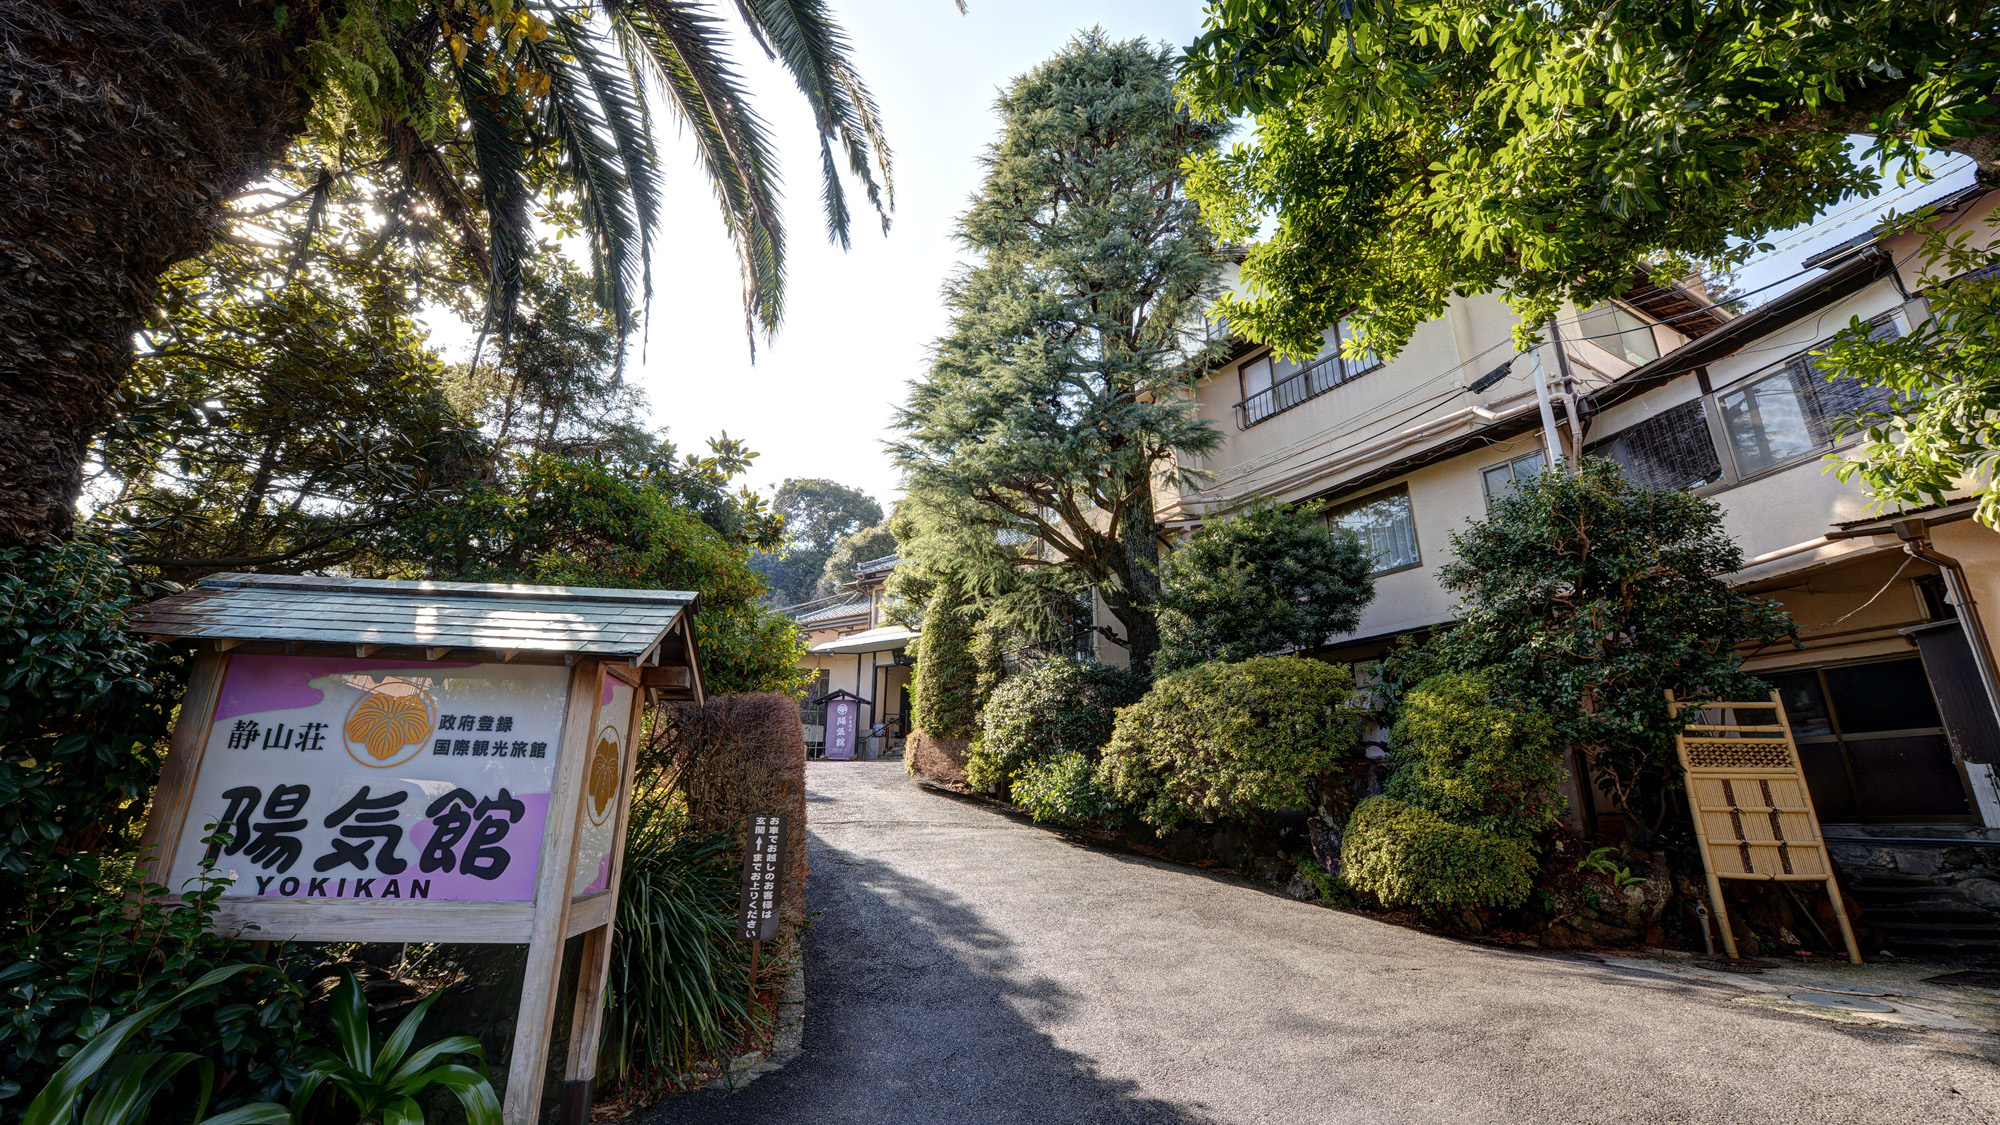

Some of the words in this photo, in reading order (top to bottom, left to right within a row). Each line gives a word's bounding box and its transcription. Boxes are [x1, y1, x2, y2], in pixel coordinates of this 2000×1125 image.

[227, 719, 329, 751] 静山荘
[438, 714, 514, 733] 政府登録
[432, 739, 548, 759] 国際観光旅館
[203, 784, 526, 881] 陽気館
[755, 817, 766, 835] 玄関
[761, 817, 780, 919] お車でお越しのお客様は
[255, 875, 431, 899] YOKIKAN
[745, 854, 763, 938] までお上りください
